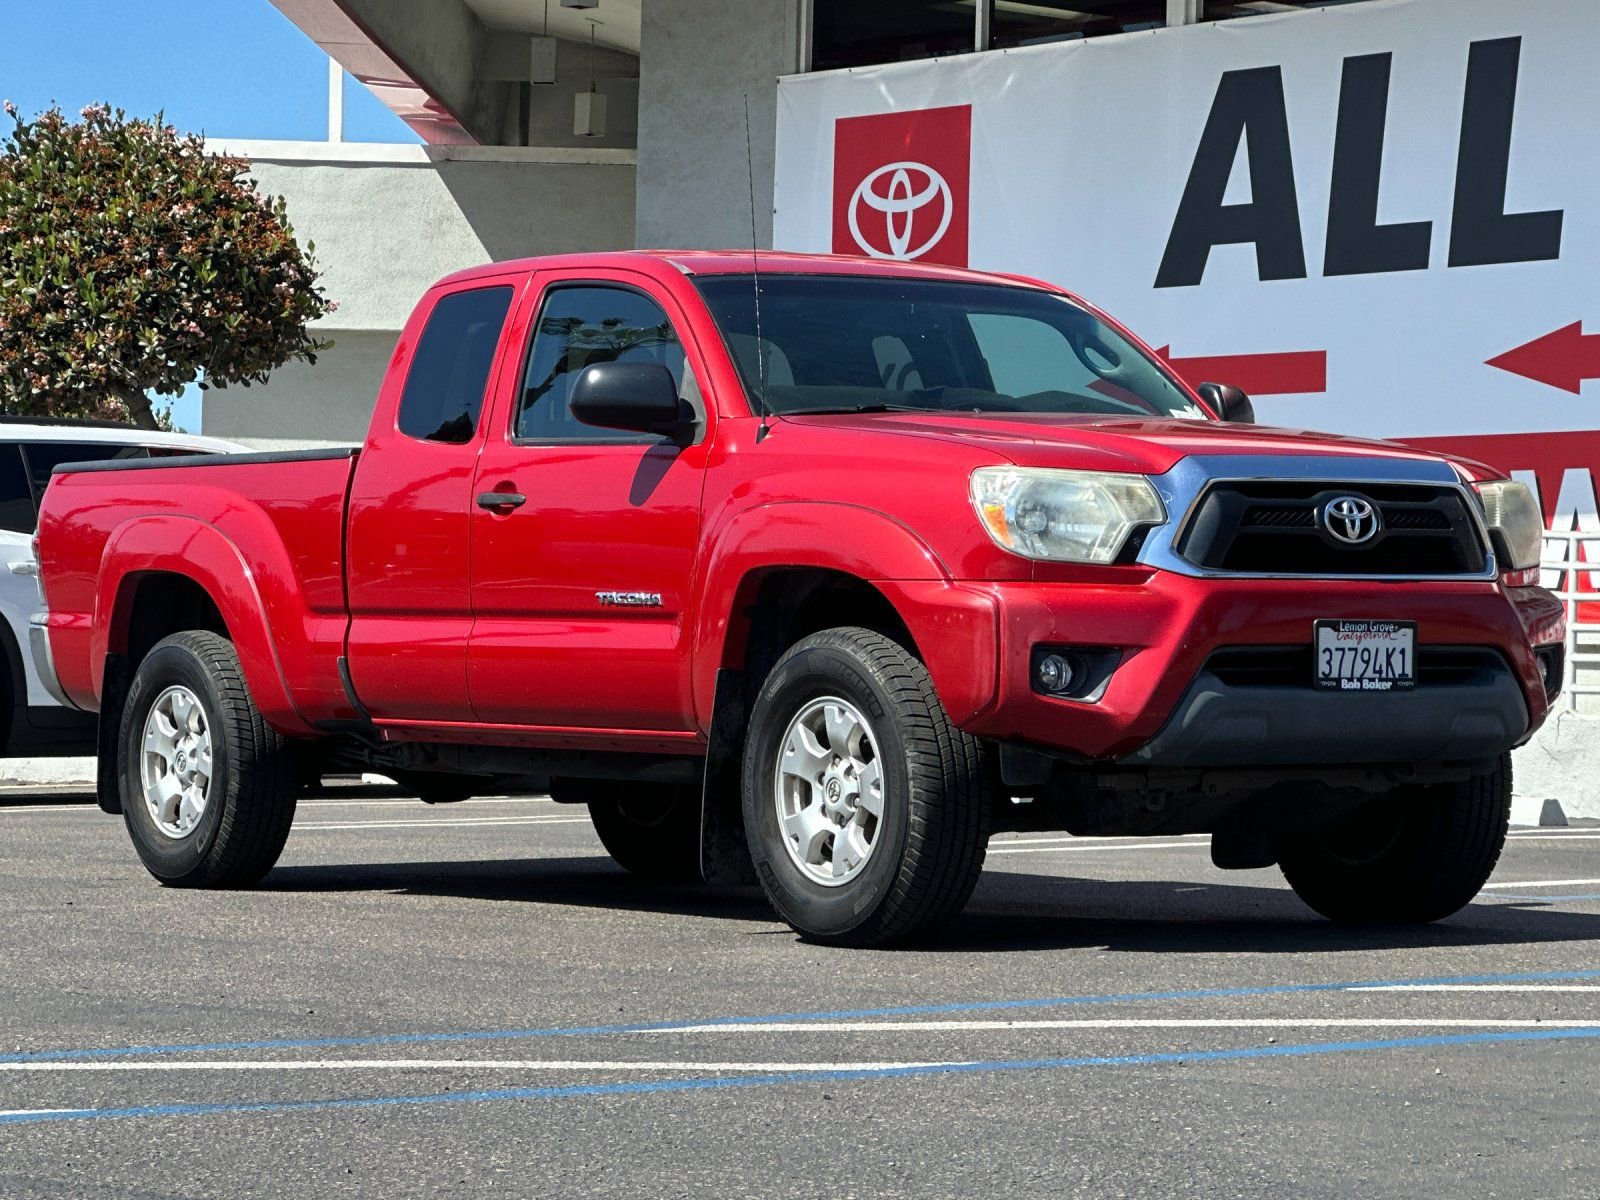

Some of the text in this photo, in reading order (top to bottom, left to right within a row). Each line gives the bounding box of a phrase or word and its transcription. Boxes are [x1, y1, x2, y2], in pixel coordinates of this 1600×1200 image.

[1153, 36, 1564, 288] ALL
[595, 592, 662, 605] TACOMA
[1339, 620, 1395, 632] Lemon Grove
[1321, 647, 1409, 679] 37794K1
[1341, 678, 1393, 690] Bob Baker
